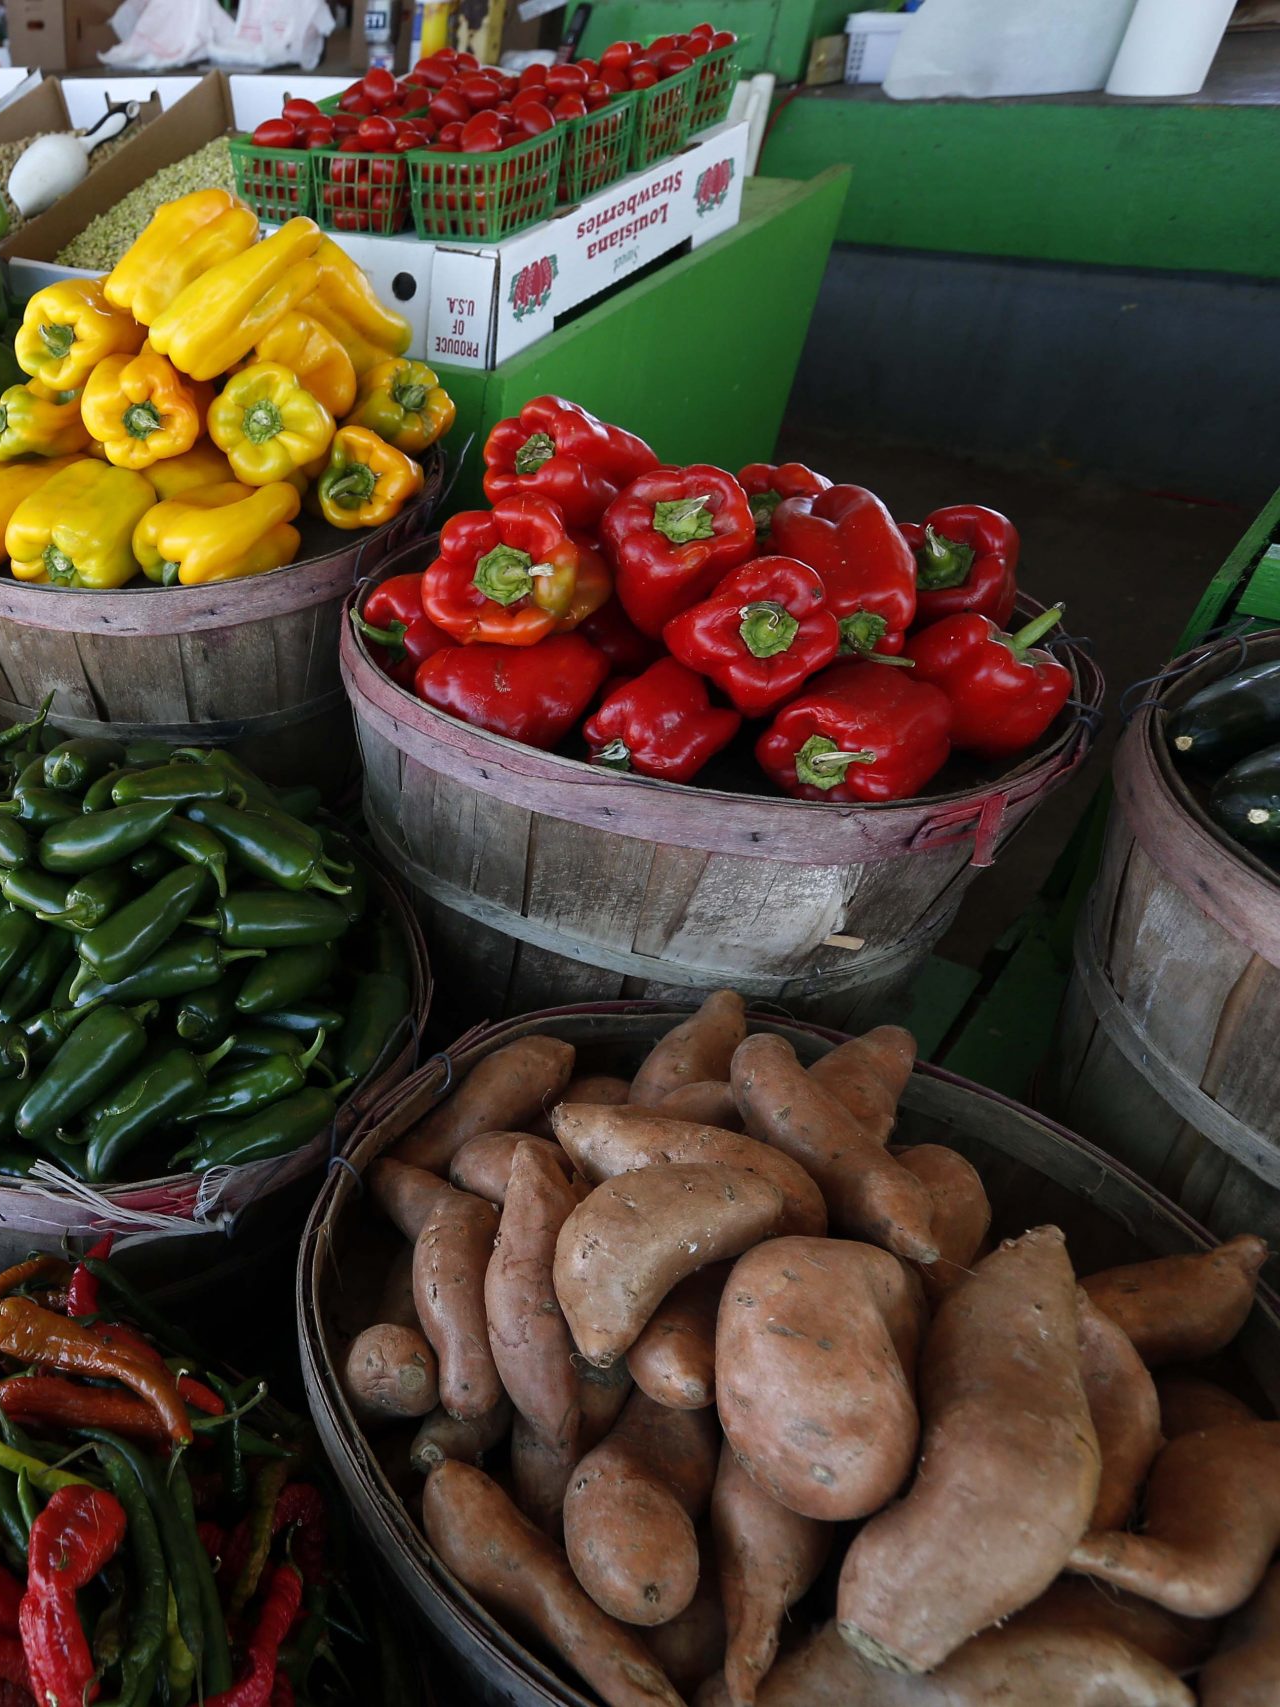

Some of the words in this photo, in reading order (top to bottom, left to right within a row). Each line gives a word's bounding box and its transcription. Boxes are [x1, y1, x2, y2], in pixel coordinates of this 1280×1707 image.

[576, 170, 683, 240] Strawberries
[587, 203, 669, 260] Louisiana
[446, 297, 475, 317] U.S.A.
[452, 319, 465, 335] OF
[435, 336, 479, 358] PRODUCE
